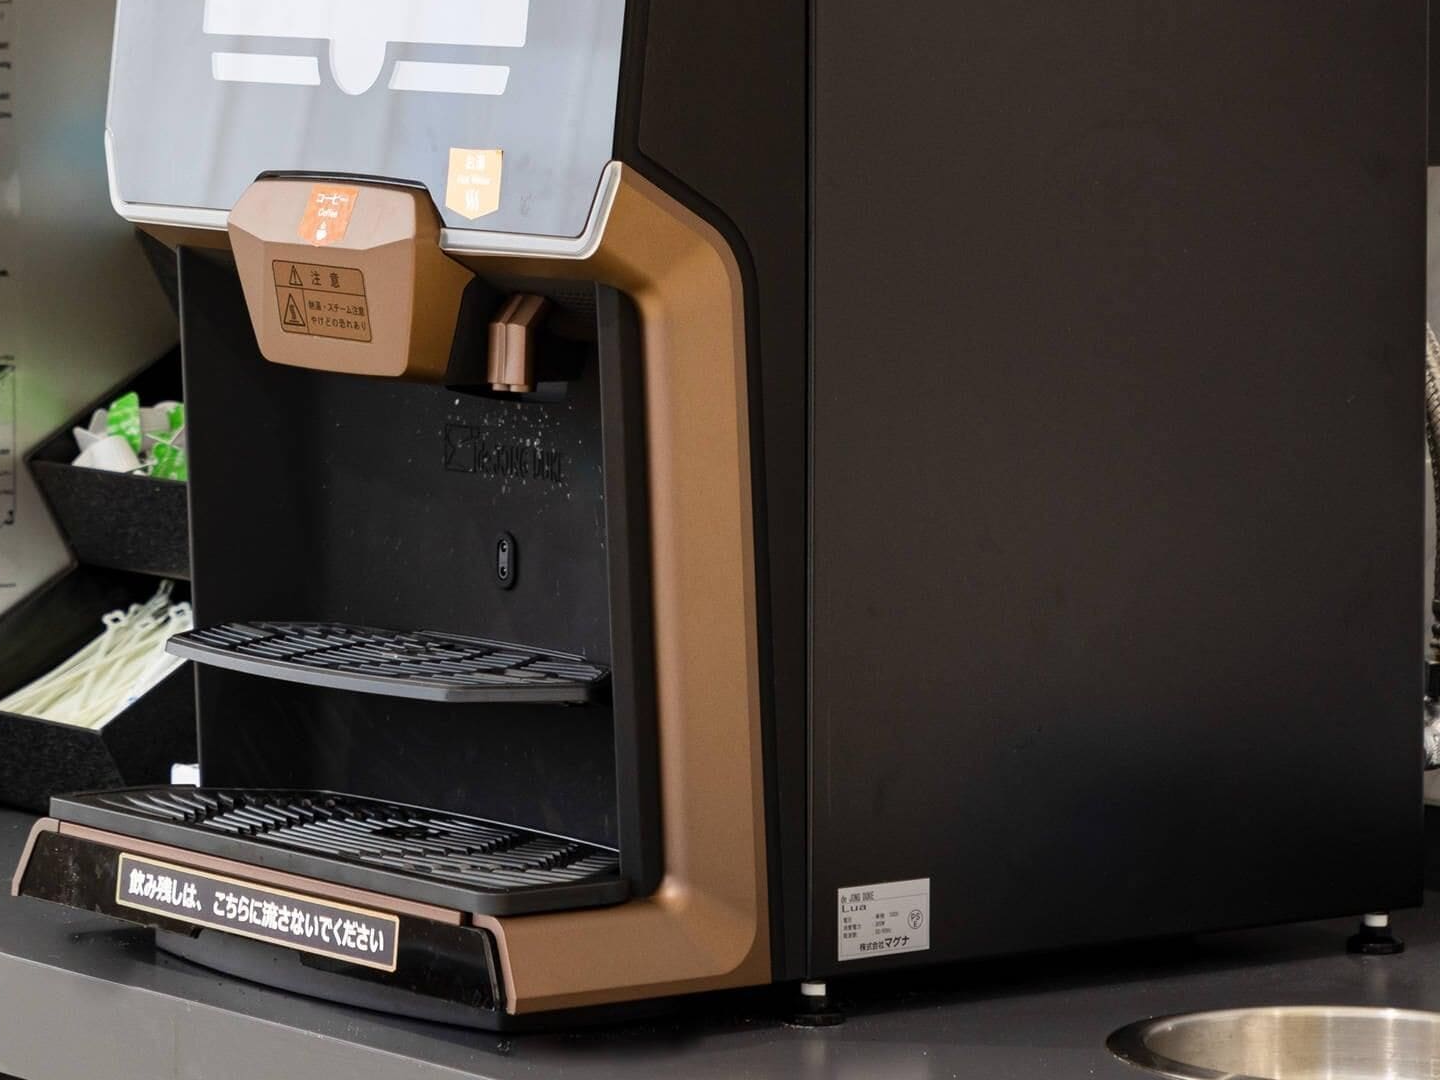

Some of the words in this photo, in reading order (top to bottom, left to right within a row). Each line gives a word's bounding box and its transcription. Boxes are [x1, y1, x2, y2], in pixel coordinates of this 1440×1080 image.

[316, 193, 349, 206] コーヒー
[310, 271, 340, 289] 注意
[859, 935, 910, 952] 株式会社マグナ
